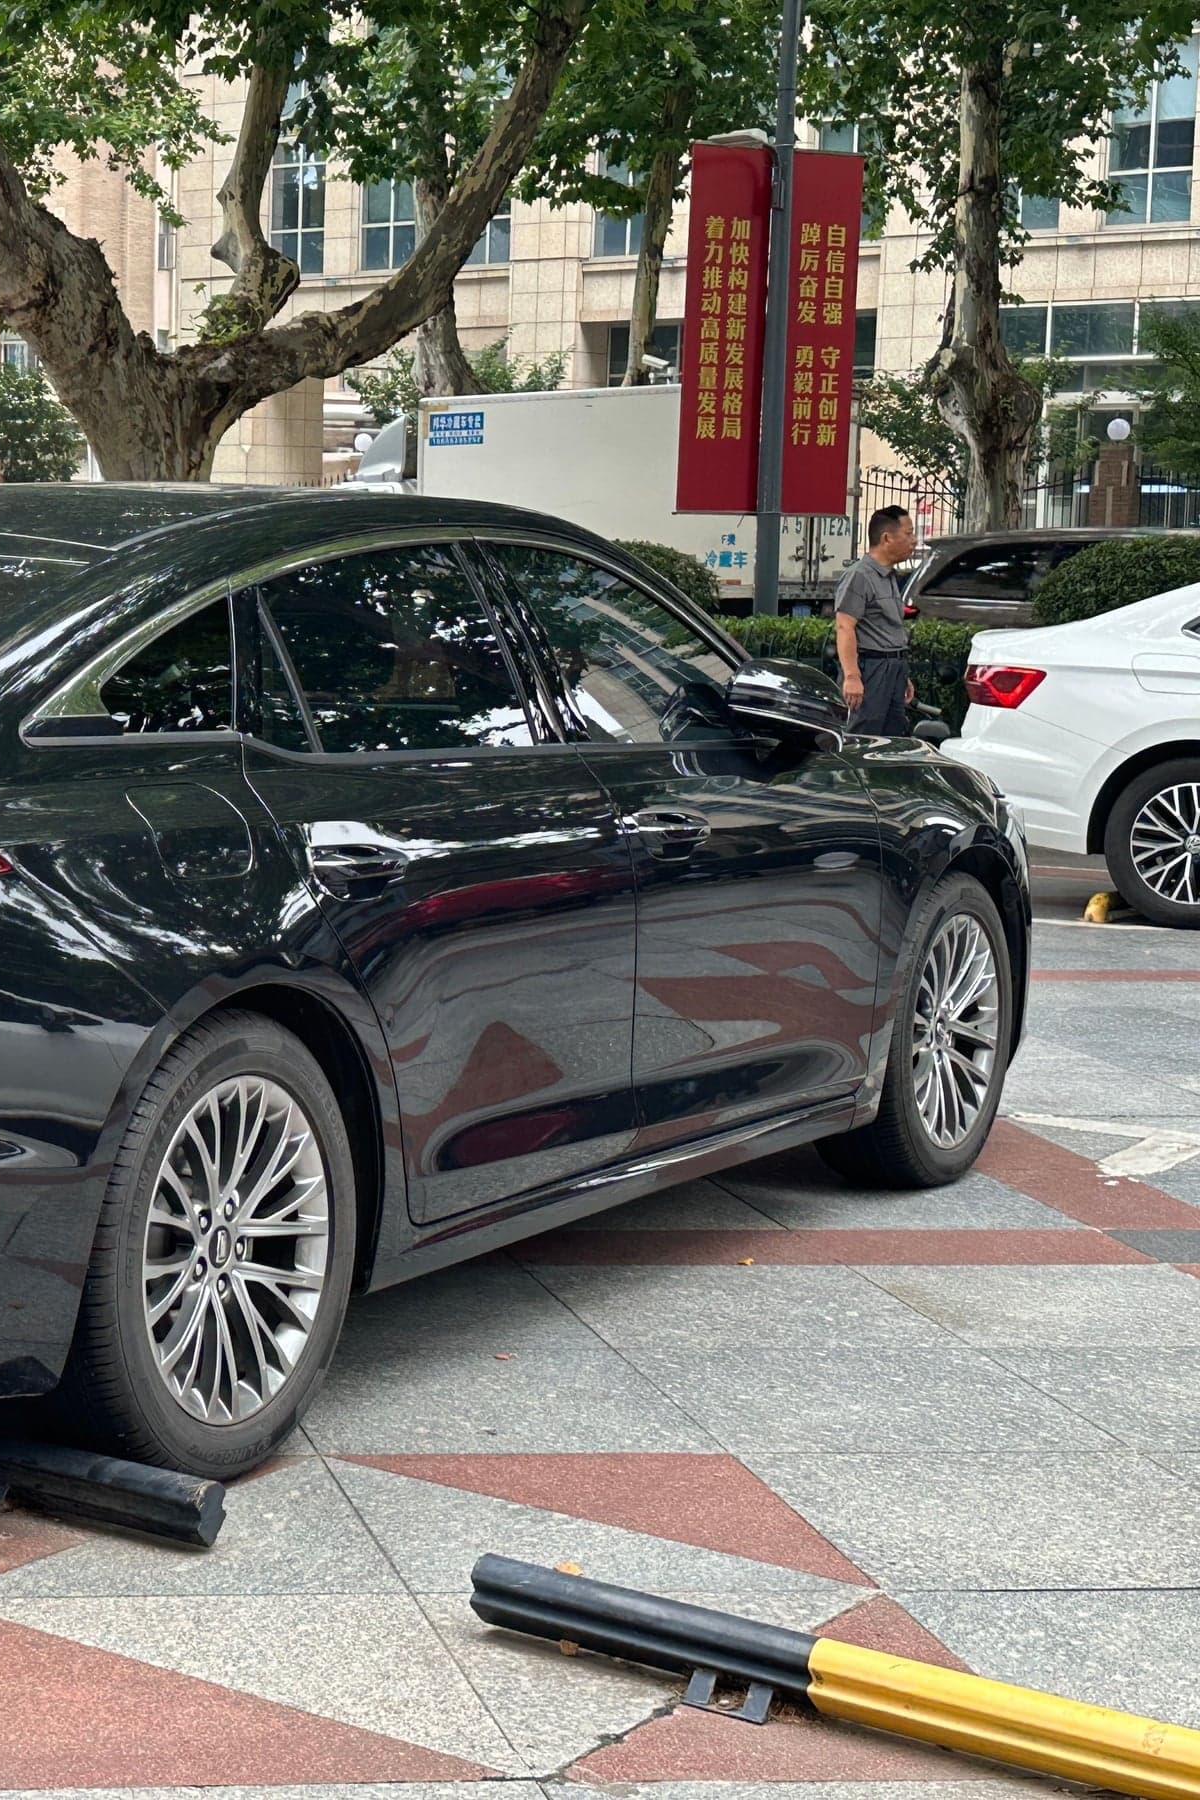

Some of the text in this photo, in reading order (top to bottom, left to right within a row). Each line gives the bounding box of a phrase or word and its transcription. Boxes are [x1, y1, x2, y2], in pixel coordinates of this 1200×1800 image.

[695, 216, 725, 440] 着力推动高质量发展
[720, 216, 751, 440] 加快构建新发展格局
[790, 223, 821, 446] 踔厉奋发 勇毅前行
[815, 224, 847, 447] 自信自强 守正创新
[705, 550, 748, 568] 冷藏车
